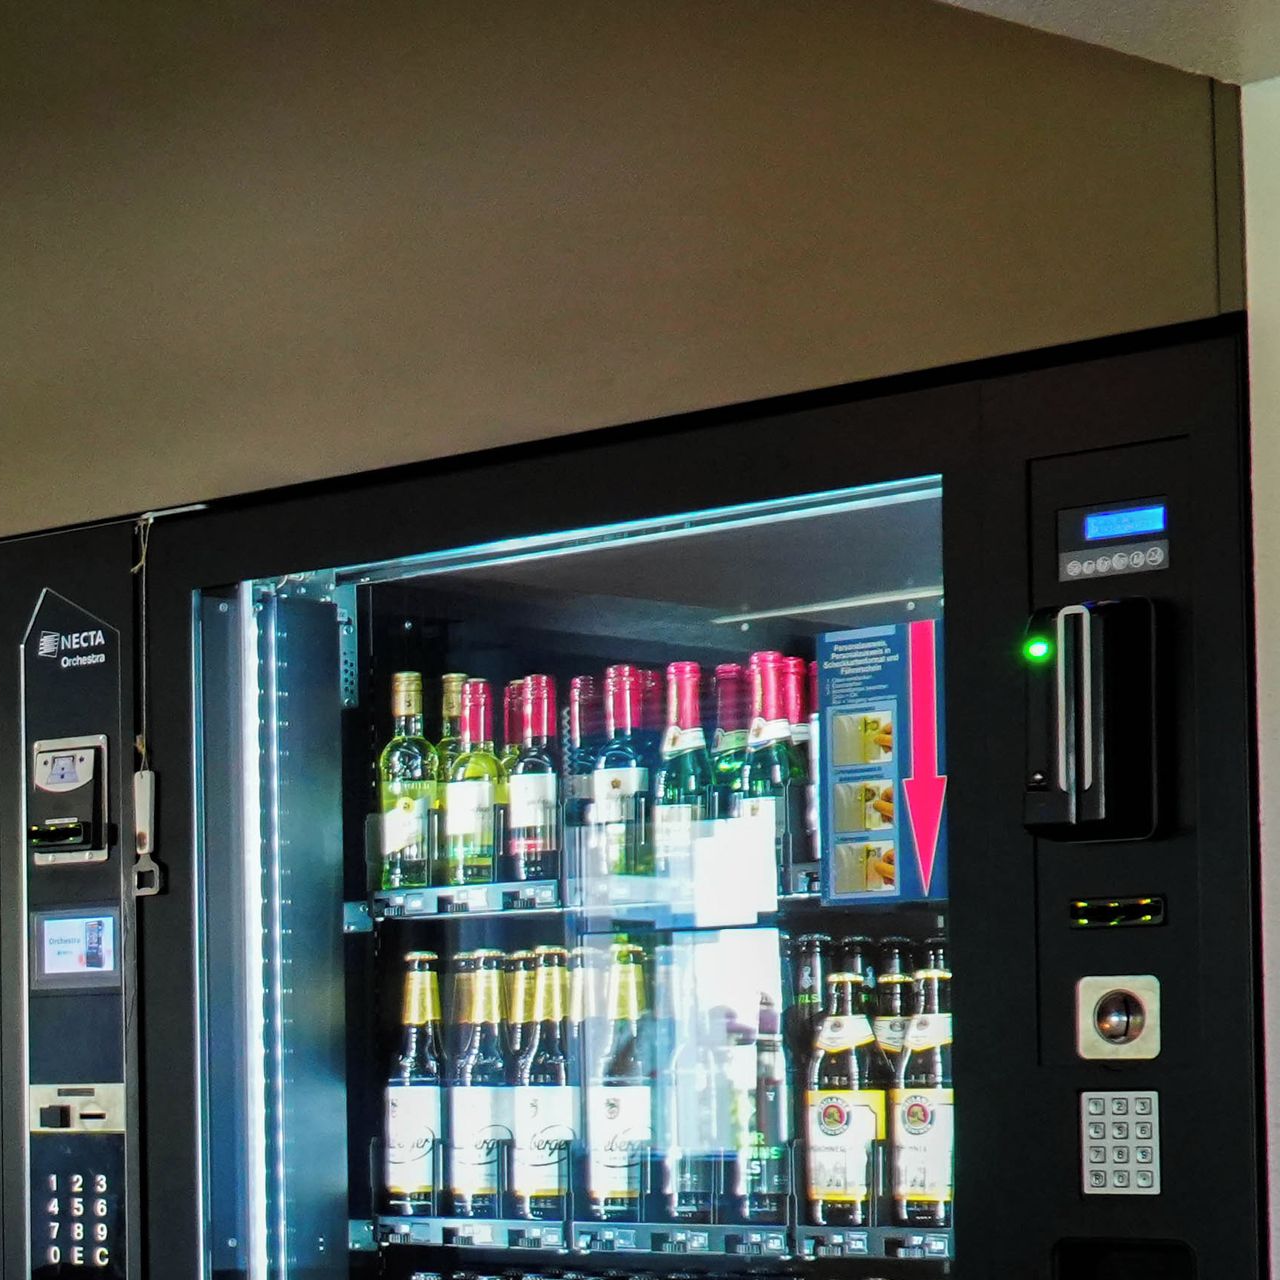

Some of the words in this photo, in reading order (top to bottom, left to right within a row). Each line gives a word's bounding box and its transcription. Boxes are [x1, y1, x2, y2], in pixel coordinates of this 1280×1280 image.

[61, 629, 106, 650] NECTA
[61, 653, 106, 668] Orchestra
[48, 1174, 57, 1192] 1
[70, 1174, 83, 1192] 2
[94, 1174, 107, 1192] 3
[47, 1198, 59, 1217] 4
[70, 1198, 84, 1217] 5
[93, 1198, 107, 1217] 6
[48, 1222, 59, 1241] 7
[70, 1222, 84, 1241] 8
[94, 1222, 108, 1241] 9
[48, 1246, 60, 1266] 0
[70, 1246, 84, 1266] E
[94, 1246, 109, 1267] C
